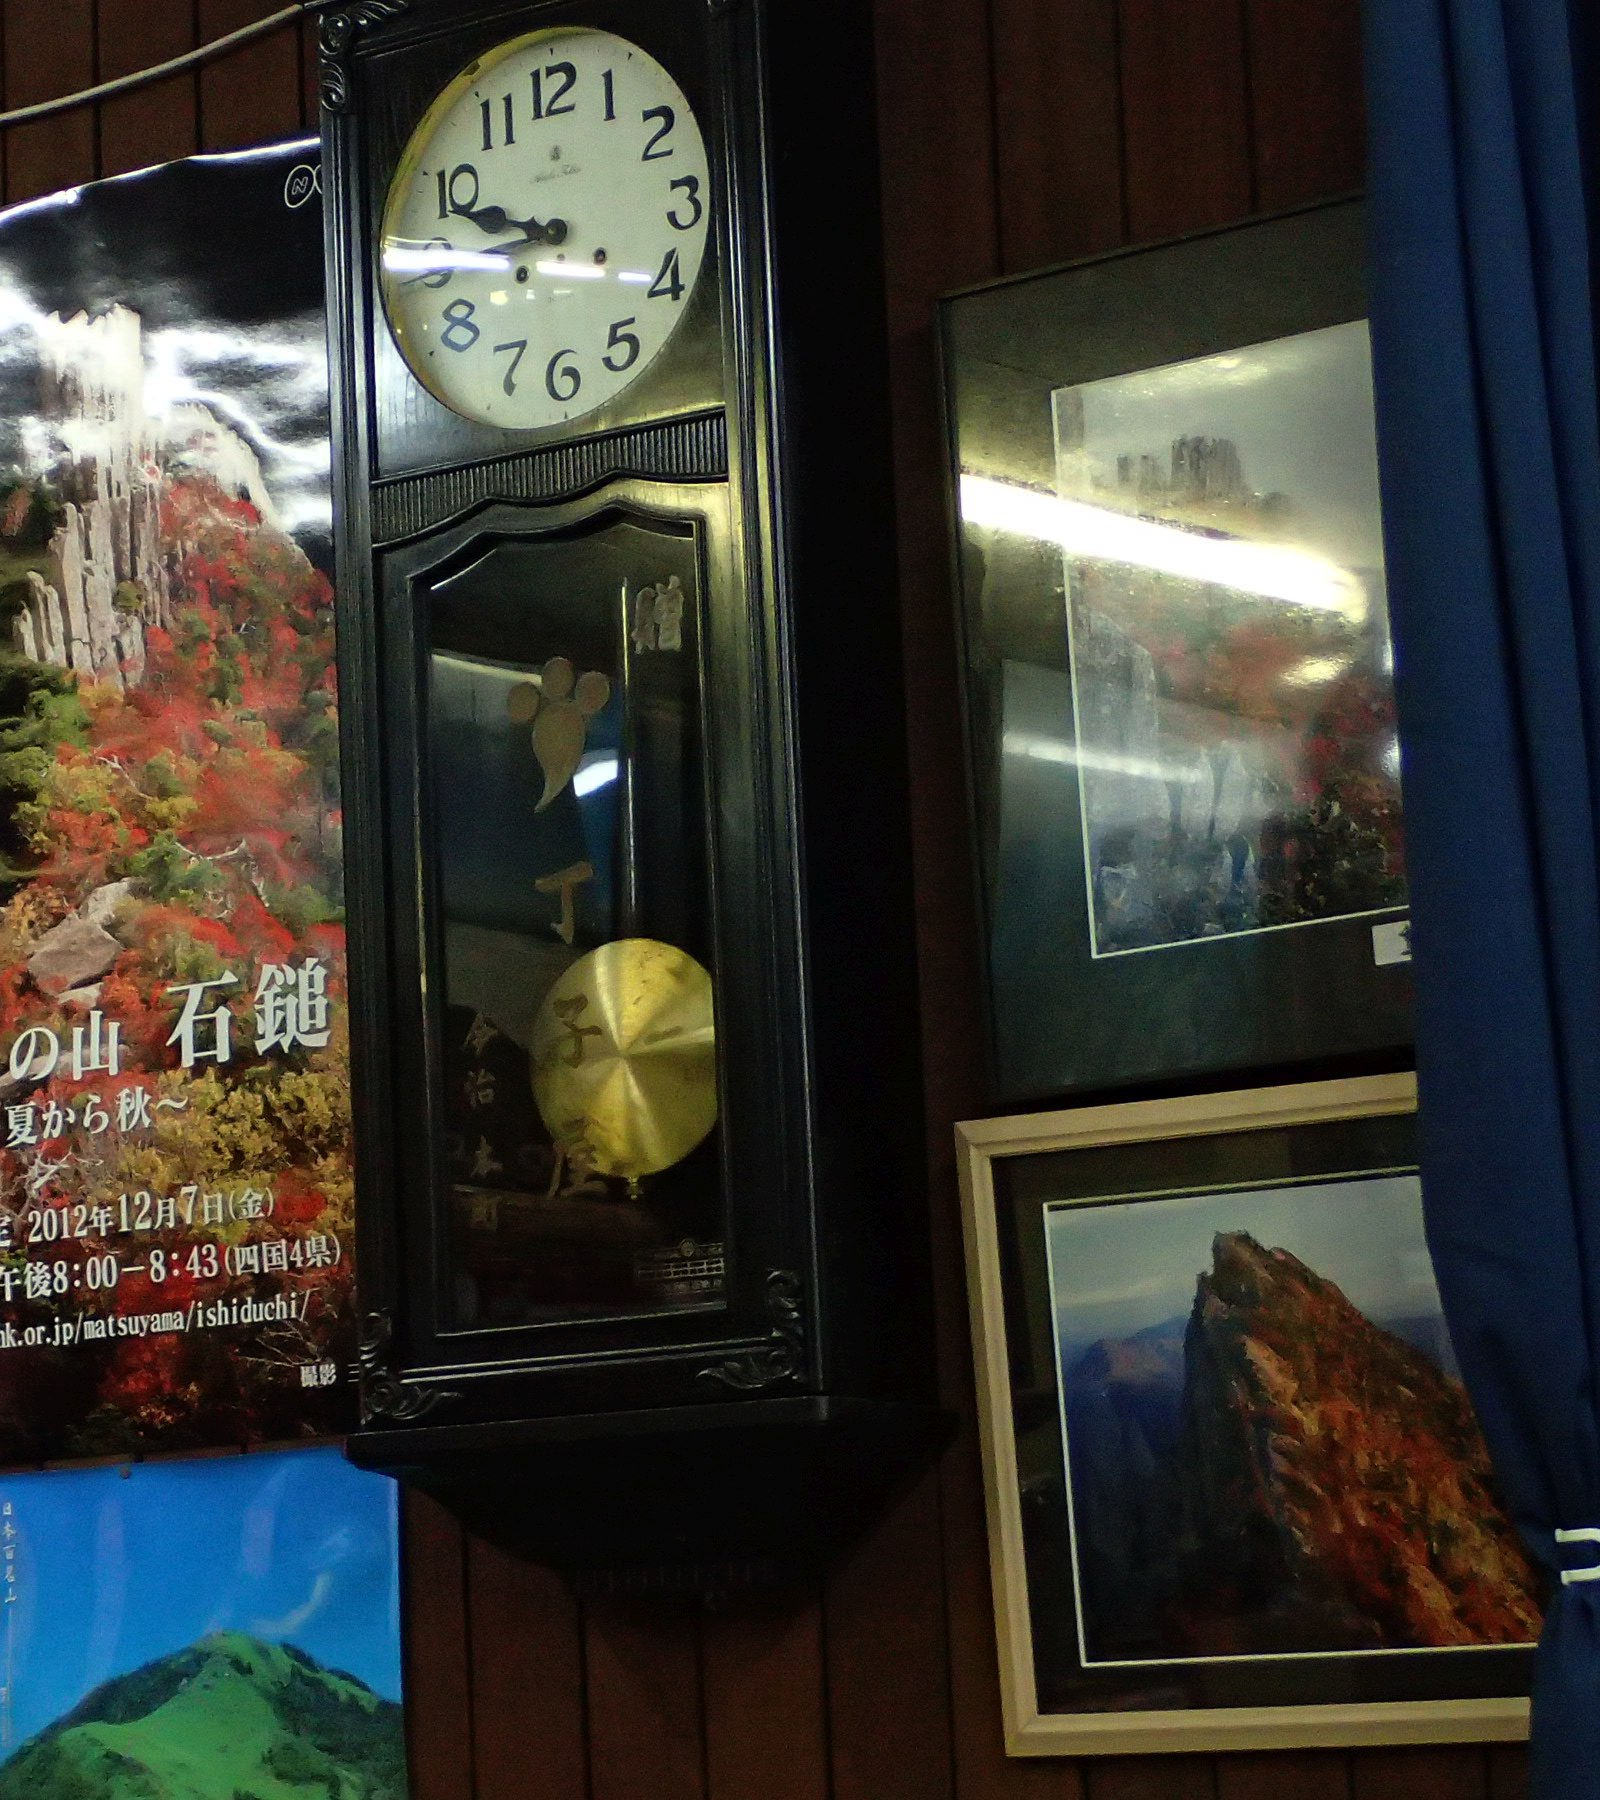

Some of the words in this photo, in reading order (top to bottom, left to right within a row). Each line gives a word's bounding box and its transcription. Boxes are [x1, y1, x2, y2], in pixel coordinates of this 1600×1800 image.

[530, 61, 577, 120] 12
[602, 69, 616, 121] 1
[480, 93, 516, 150] 11
[641, 105, 675, 161] 2
[436, 163, 479, 219] 10
[666, 175, 702, 230] 3
[647, 247, 685, 301] 4
[440, 299, 480, 352] 8
[602, 317, 640, 371] 5
[493, 340, 527, 396] 7
[545, 349, 581, 401] 6
